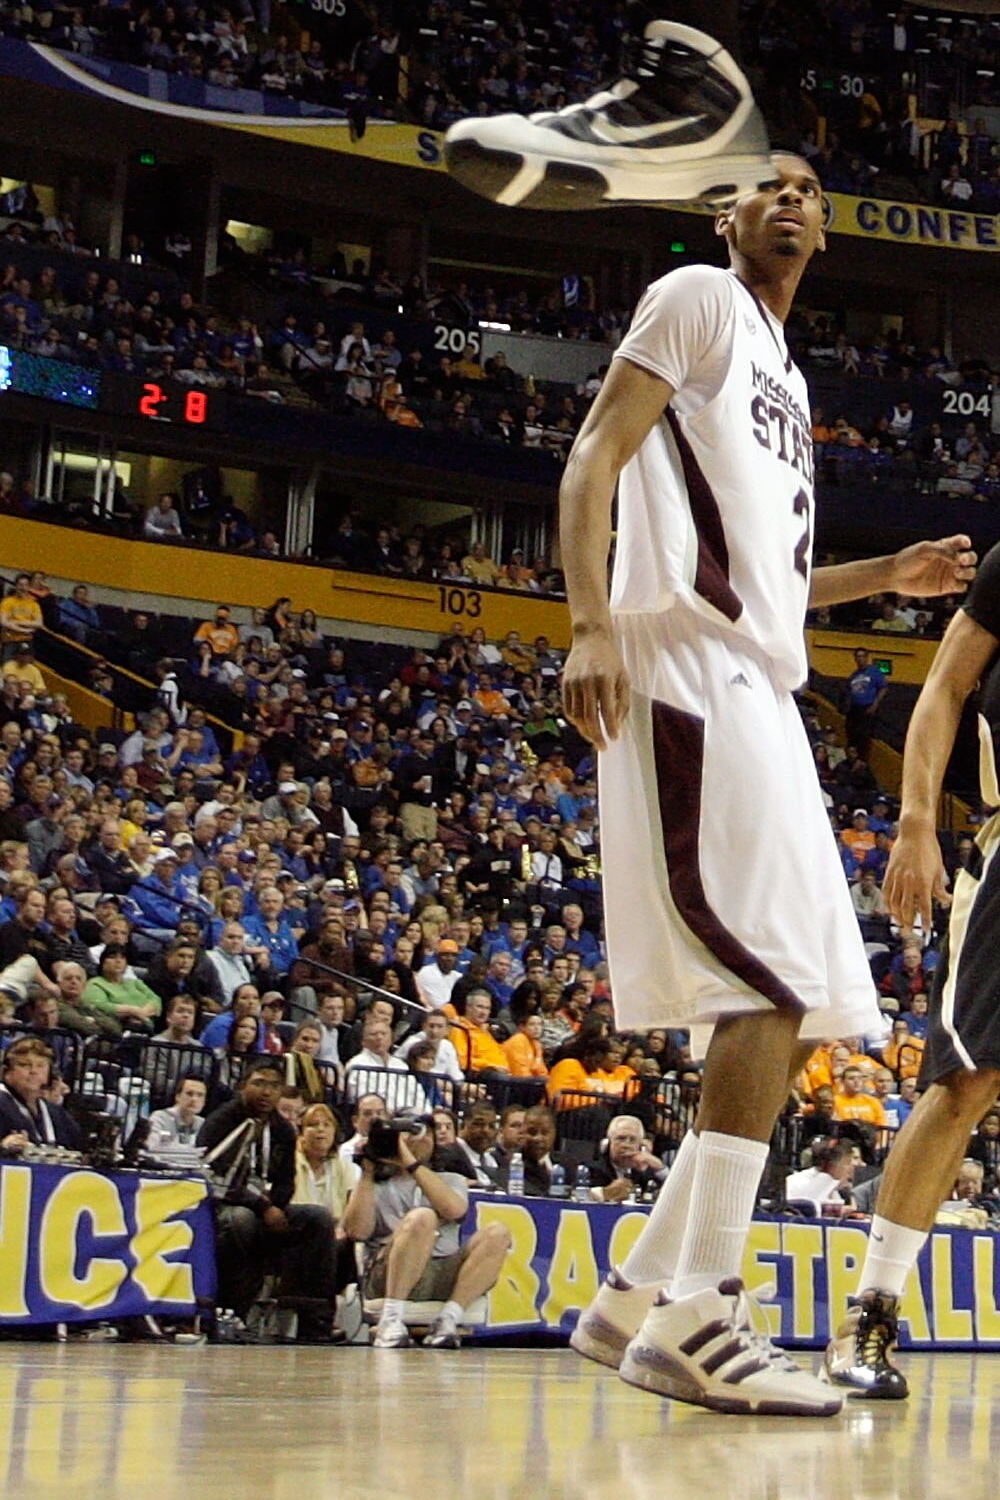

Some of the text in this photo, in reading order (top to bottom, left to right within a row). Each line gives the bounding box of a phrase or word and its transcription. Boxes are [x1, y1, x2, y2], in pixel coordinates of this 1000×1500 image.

[839, 75, 864, 97] 30
[434, 325, 480, 354] 205
[942, 389, 992, 417] 204
[751, 394, 814, 486] STAT
[439, 586, 481, 617] 103
